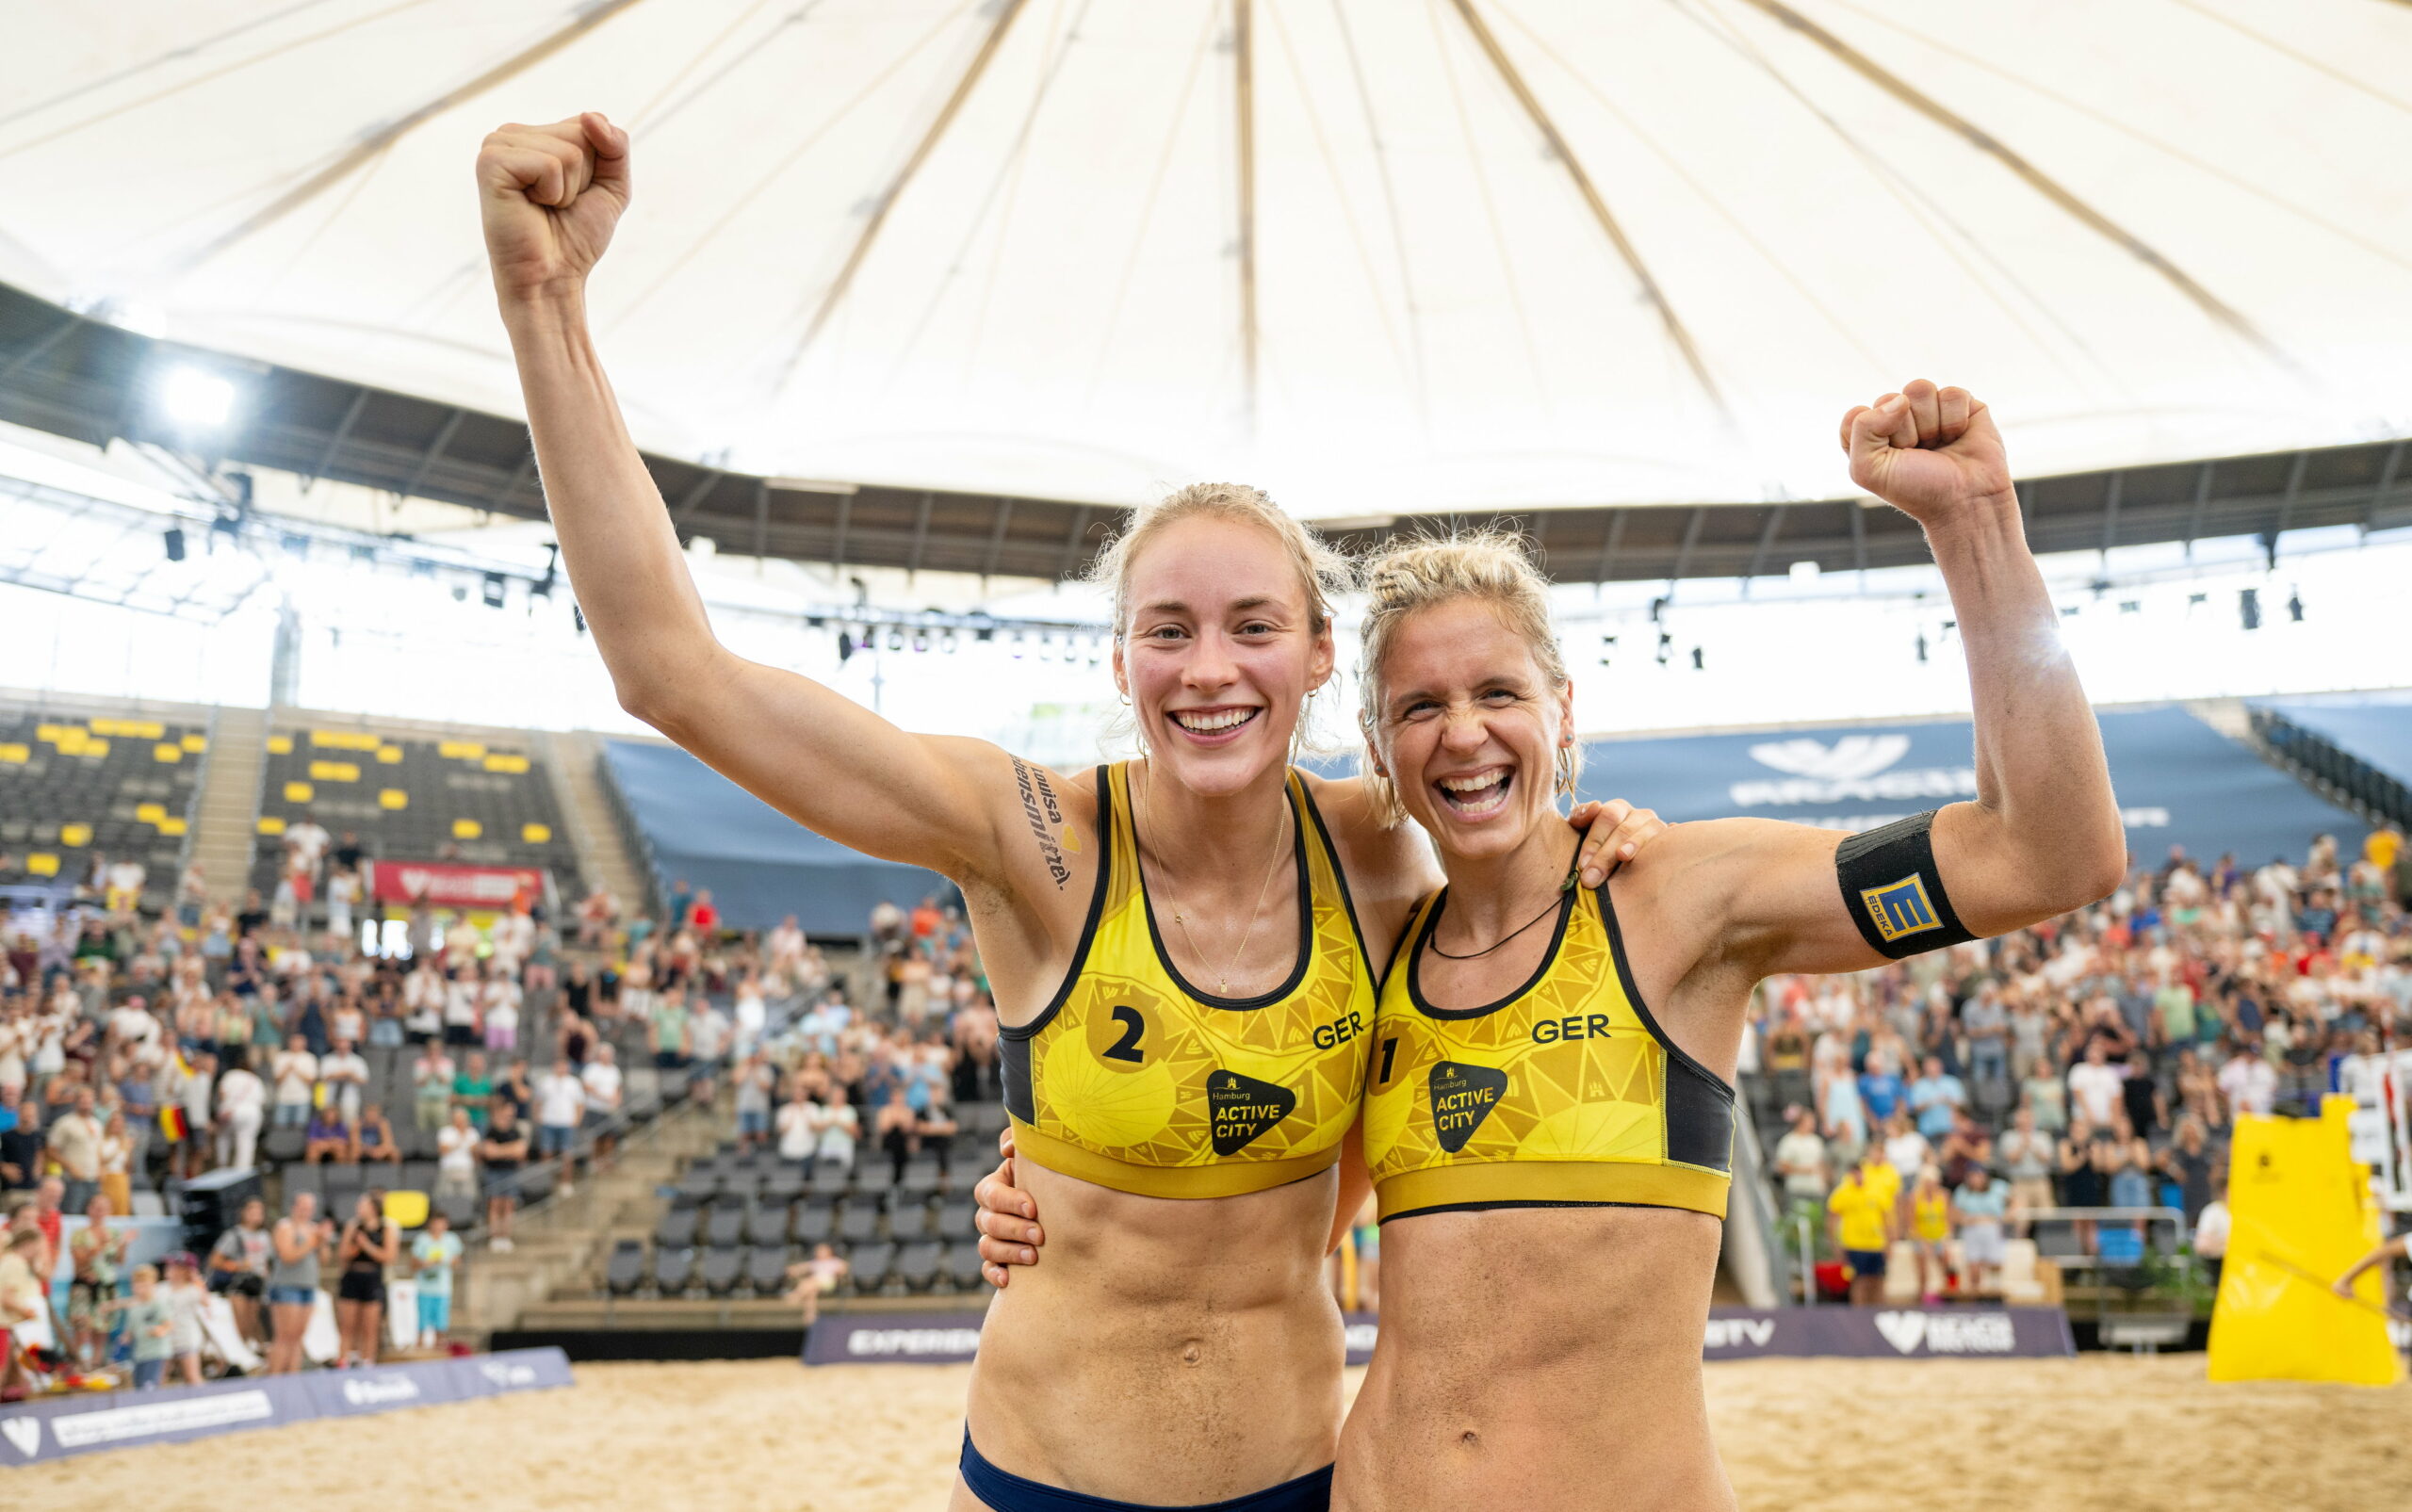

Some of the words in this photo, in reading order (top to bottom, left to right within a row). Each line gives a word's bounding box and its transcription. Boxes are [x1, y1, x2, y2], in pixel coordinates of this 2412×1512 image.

[1030, 767, 1063, 824] Louisa
[1867, 895, 1893, 936] EDEKA
[1101, 1004, 1145, 1064] 2
[1312, 1011, 1364, 1050] GER
[1531, 1014, 1612, 1045] GER
[1378, 1037, 1399, 1084] 1
[1212, 1092, 1251, 1101] Hamburg
[1433, 1079, 1467, 1091] Hamburg
[1436, 1086, 1494, 1113] ACTIVE
[1215, 1104, 1281, 1122] ACTIVE
[1438, 1110, 1475, 1131] CITY
[1215, 1123, 1258, 1139] CITY
